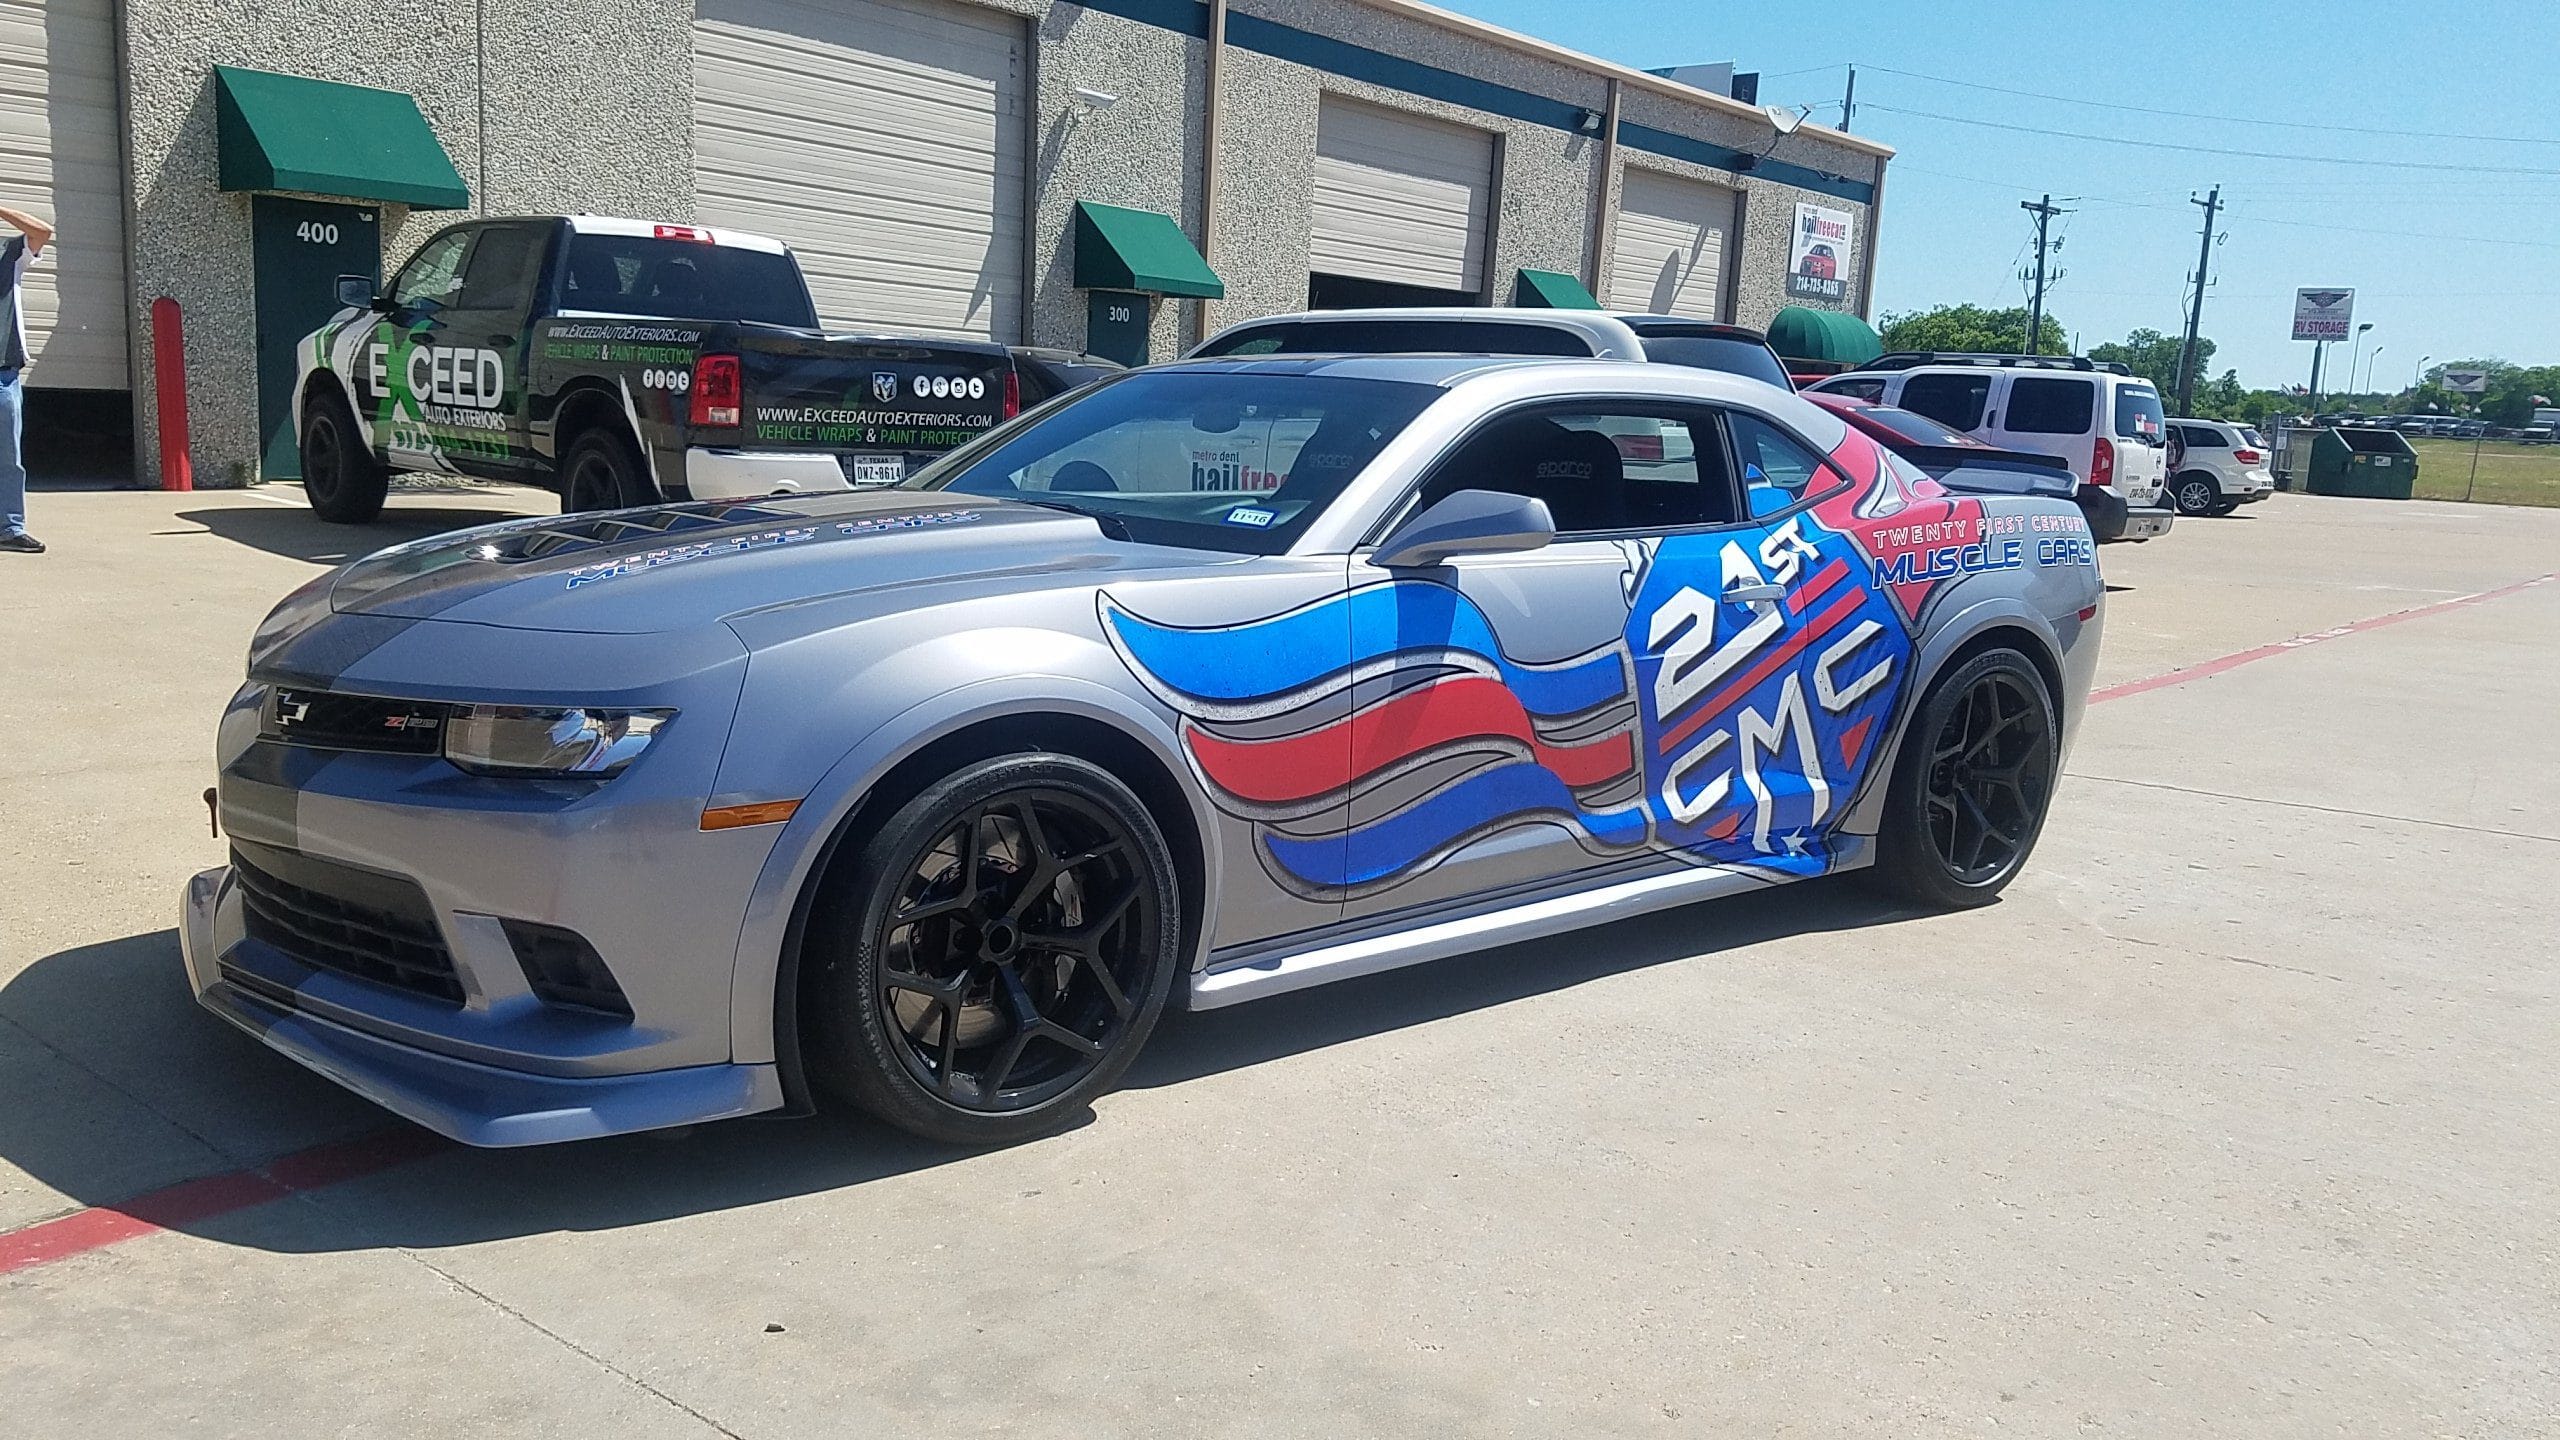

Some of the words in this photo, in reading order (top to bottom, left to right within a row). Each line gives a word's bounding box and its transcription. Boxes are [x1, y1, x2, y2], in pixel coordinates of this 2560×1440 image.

[296, 221, 339, 245] 400
[1109, 305, 1130, 322] 300
[2295, 321, 2306, 333] RV
[2307, 321, 2349, 333] STORAGE
[601, 344, 609, 360] &
[610, 346, 635, 362] PAINT
[637, 347, 693, 364] PROTECTION
[425, 406, 451, 425] AUTO
[454, 407, 507, 431] EXTERIORS
[757, 407, 993, 428] WWW.EXCEEDAUTOEXTERIORS.COM
[757, 424, 812, 441] VEHICLE
[817, 426, 863, 443] WRAPS
[866, 428, 877, 443] &
[880, 429, 915, 444] PAINT
[869, 456, 889, 464] TEXAS
[1192, 451, 1217, 462] metro
[1219, 451, 1240, 462] dent
[1537, 461, 1592, 478] sparco
[1873, 519, 1967, 549] TWENTY
[1976, 515, 2025, 536] FIRST
[2031, 515, 2086, 533] CENTURY
[1871, 539, 2025, 590] MUSCLE
[2037, 537, 2092, 567] CARS
[1661, 619, 1895, 854] CMC
